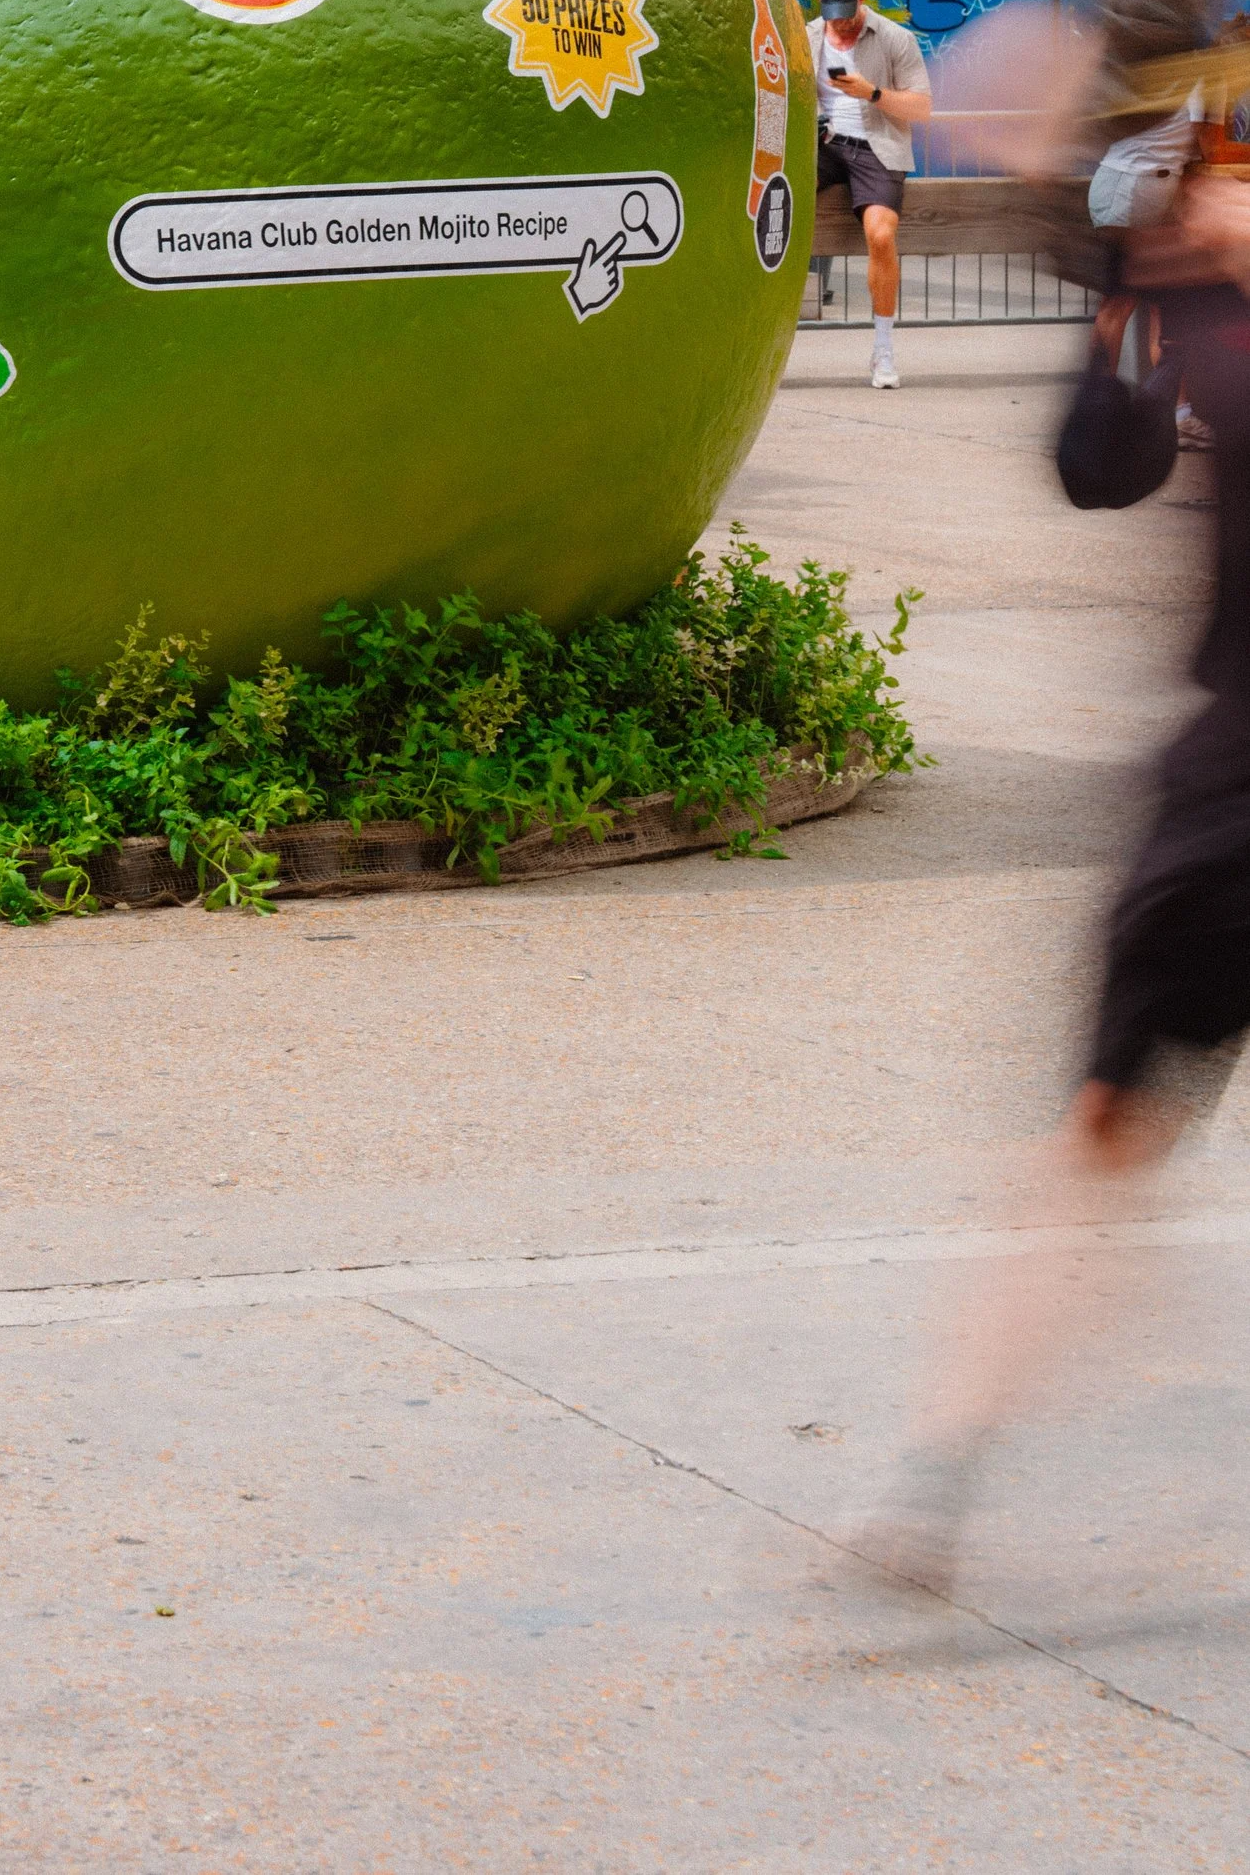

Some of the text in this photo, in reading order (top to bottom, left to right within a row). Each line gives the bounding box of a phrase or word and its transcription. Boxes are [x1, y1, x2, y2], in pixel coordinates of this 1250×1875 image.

[552, 27, 602, 59] TO WIN
[157, 211, 568, 253] Havana Club Golden Mojito Recipe
